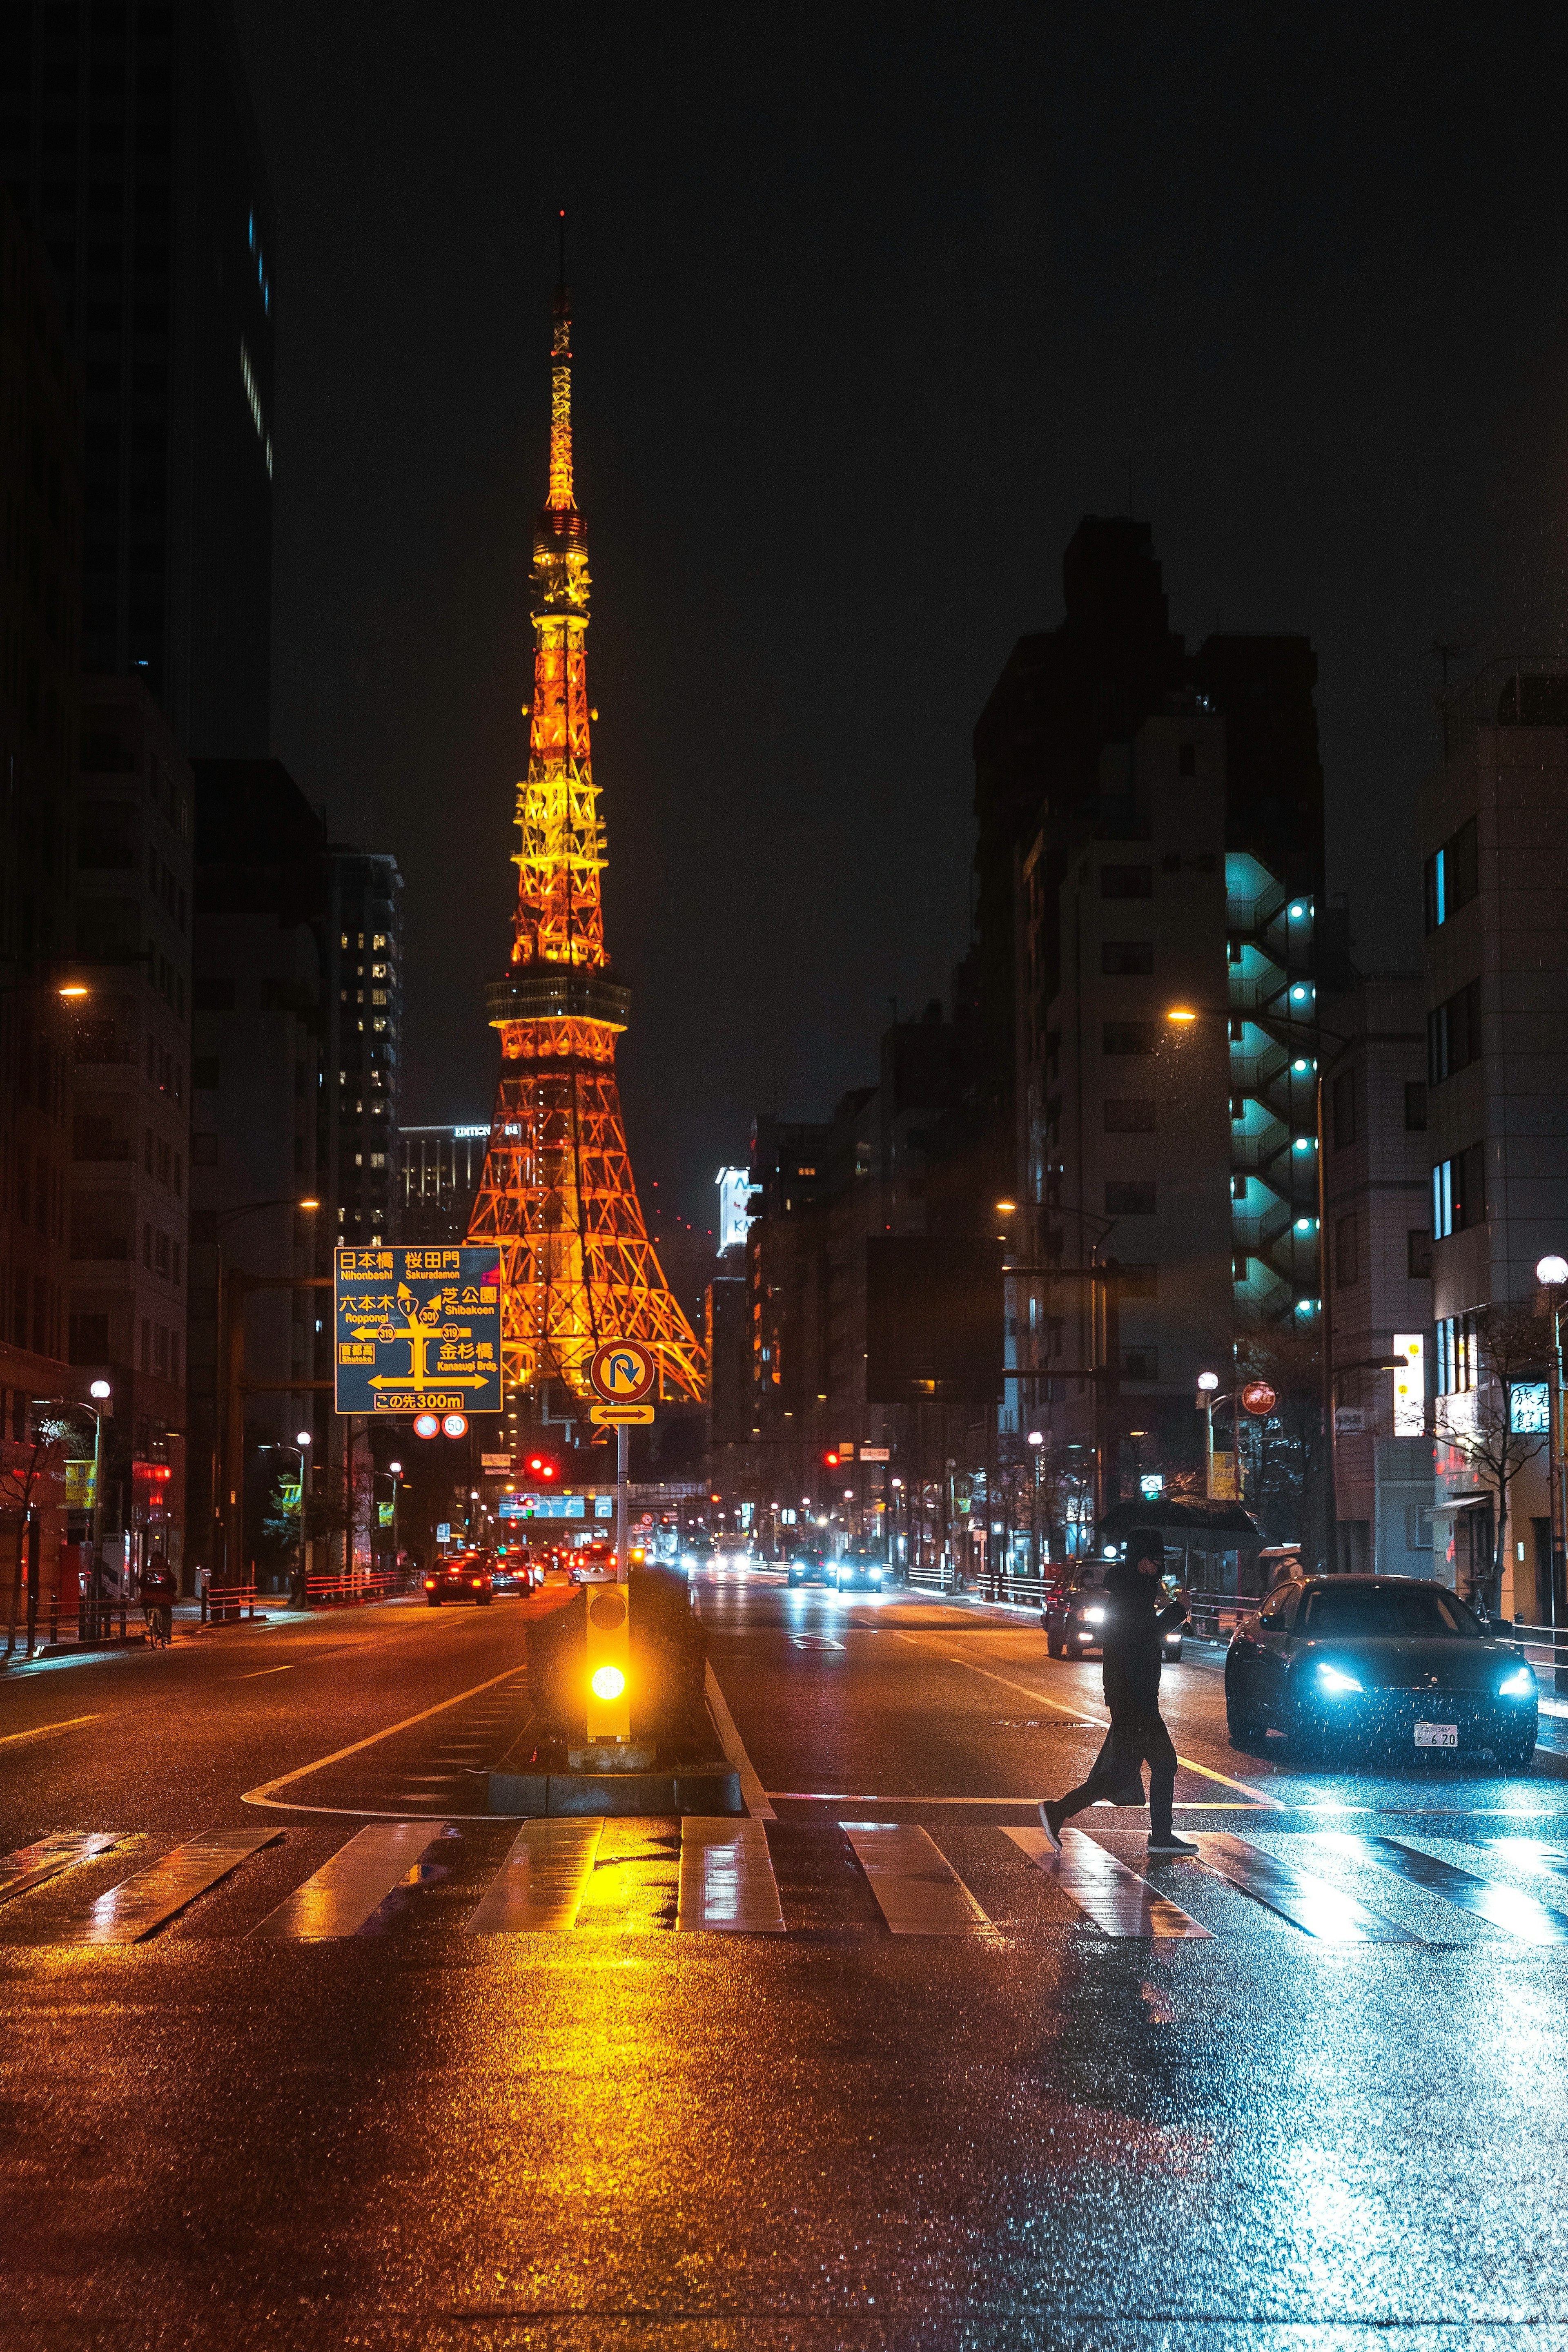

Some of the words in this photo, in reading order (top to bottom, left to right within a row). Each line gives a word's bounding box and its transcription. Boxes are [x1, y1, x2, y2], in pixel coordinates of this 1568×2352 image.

[341, 1252, 393, 1269] 日本橋
[405, 1251, 459, 1268] 桜田門
[341, 1271, 392, 1280] Nihonbashi
[406, 1270, 459, 1279] Sakuradamon
[441, 1287, 497, 1304] 芝公園
[339, 1294, 394, 1311] 六本木
[404, 1301, 410, 1312] 1
[445, 1305, 494, 1315] Shibakoen
[345, 1313, 390, 1324] Roppongi
[422, 1312, 435, 1322] 301
[380, 1328, 393, 1338] 319
[444, 1327, 457, 1337] 319
[440, 1341, 493, 1360] 金杉橋
[437, 1361, 475, 1372] Kanasugi
[477, 1361, 498, 1372] Brdg.
[376, 1394, 461, 1409] この先300m
[448, 1420, 462, 1431] 50
